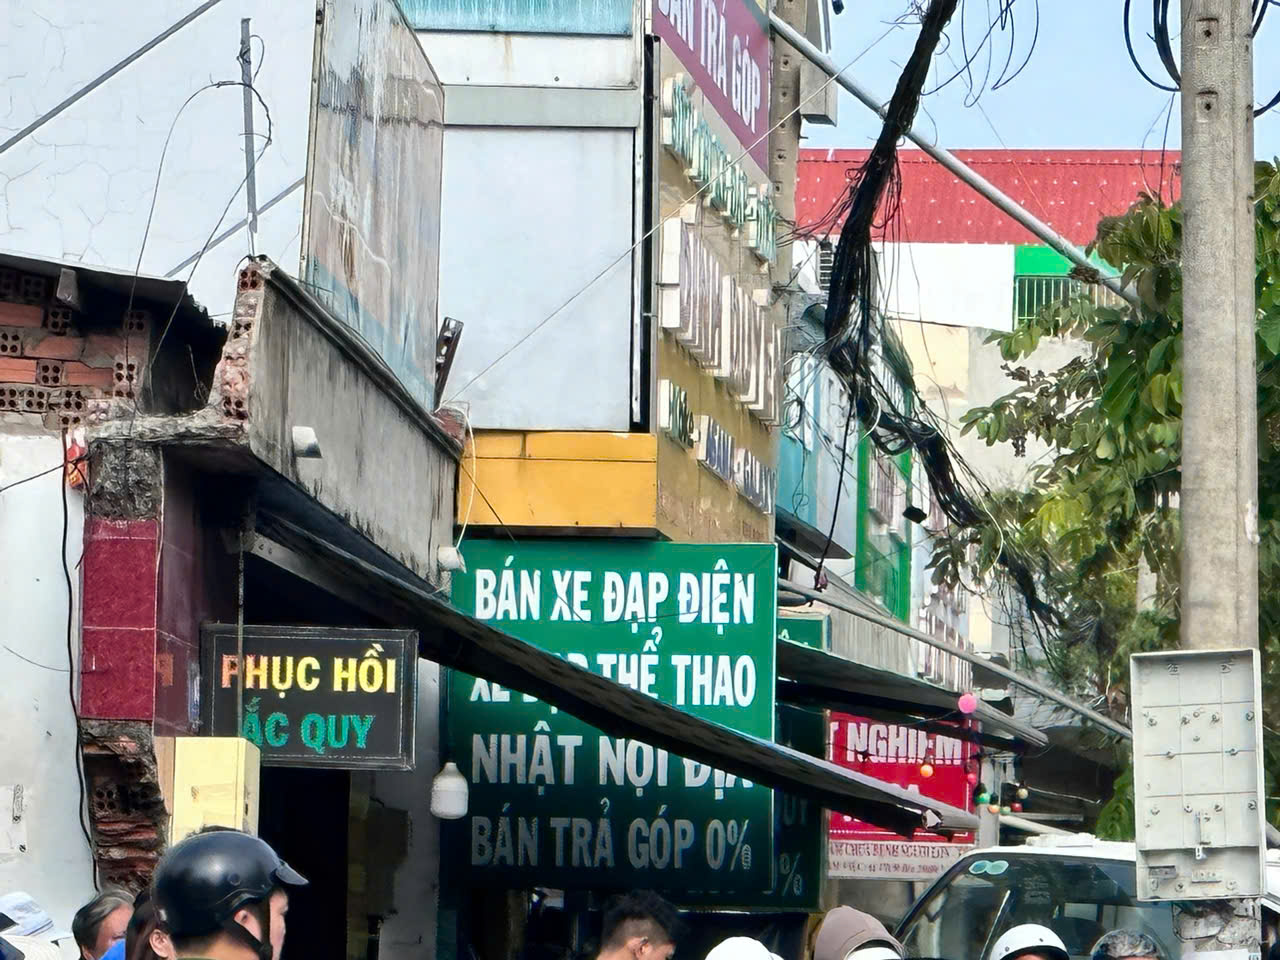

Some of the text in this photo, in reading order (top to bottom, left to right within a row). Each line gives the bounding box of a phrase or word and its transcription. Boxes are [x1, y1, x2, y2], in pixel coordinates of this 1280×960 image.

[732, 34, 761, 134] GÓP
[475, 555, 755, 634] BÁN XE ĐẠP ĐIỆN
[221, 643, 396, 698] PHỤC HỒI
[671, 654, 756, 707] THAO
[300, 713, 376, 754] QUY
[472, 720, 584, 795] NHẬT
[471, 797, 752, 872] BÁN TRẢ GÓP 0%
